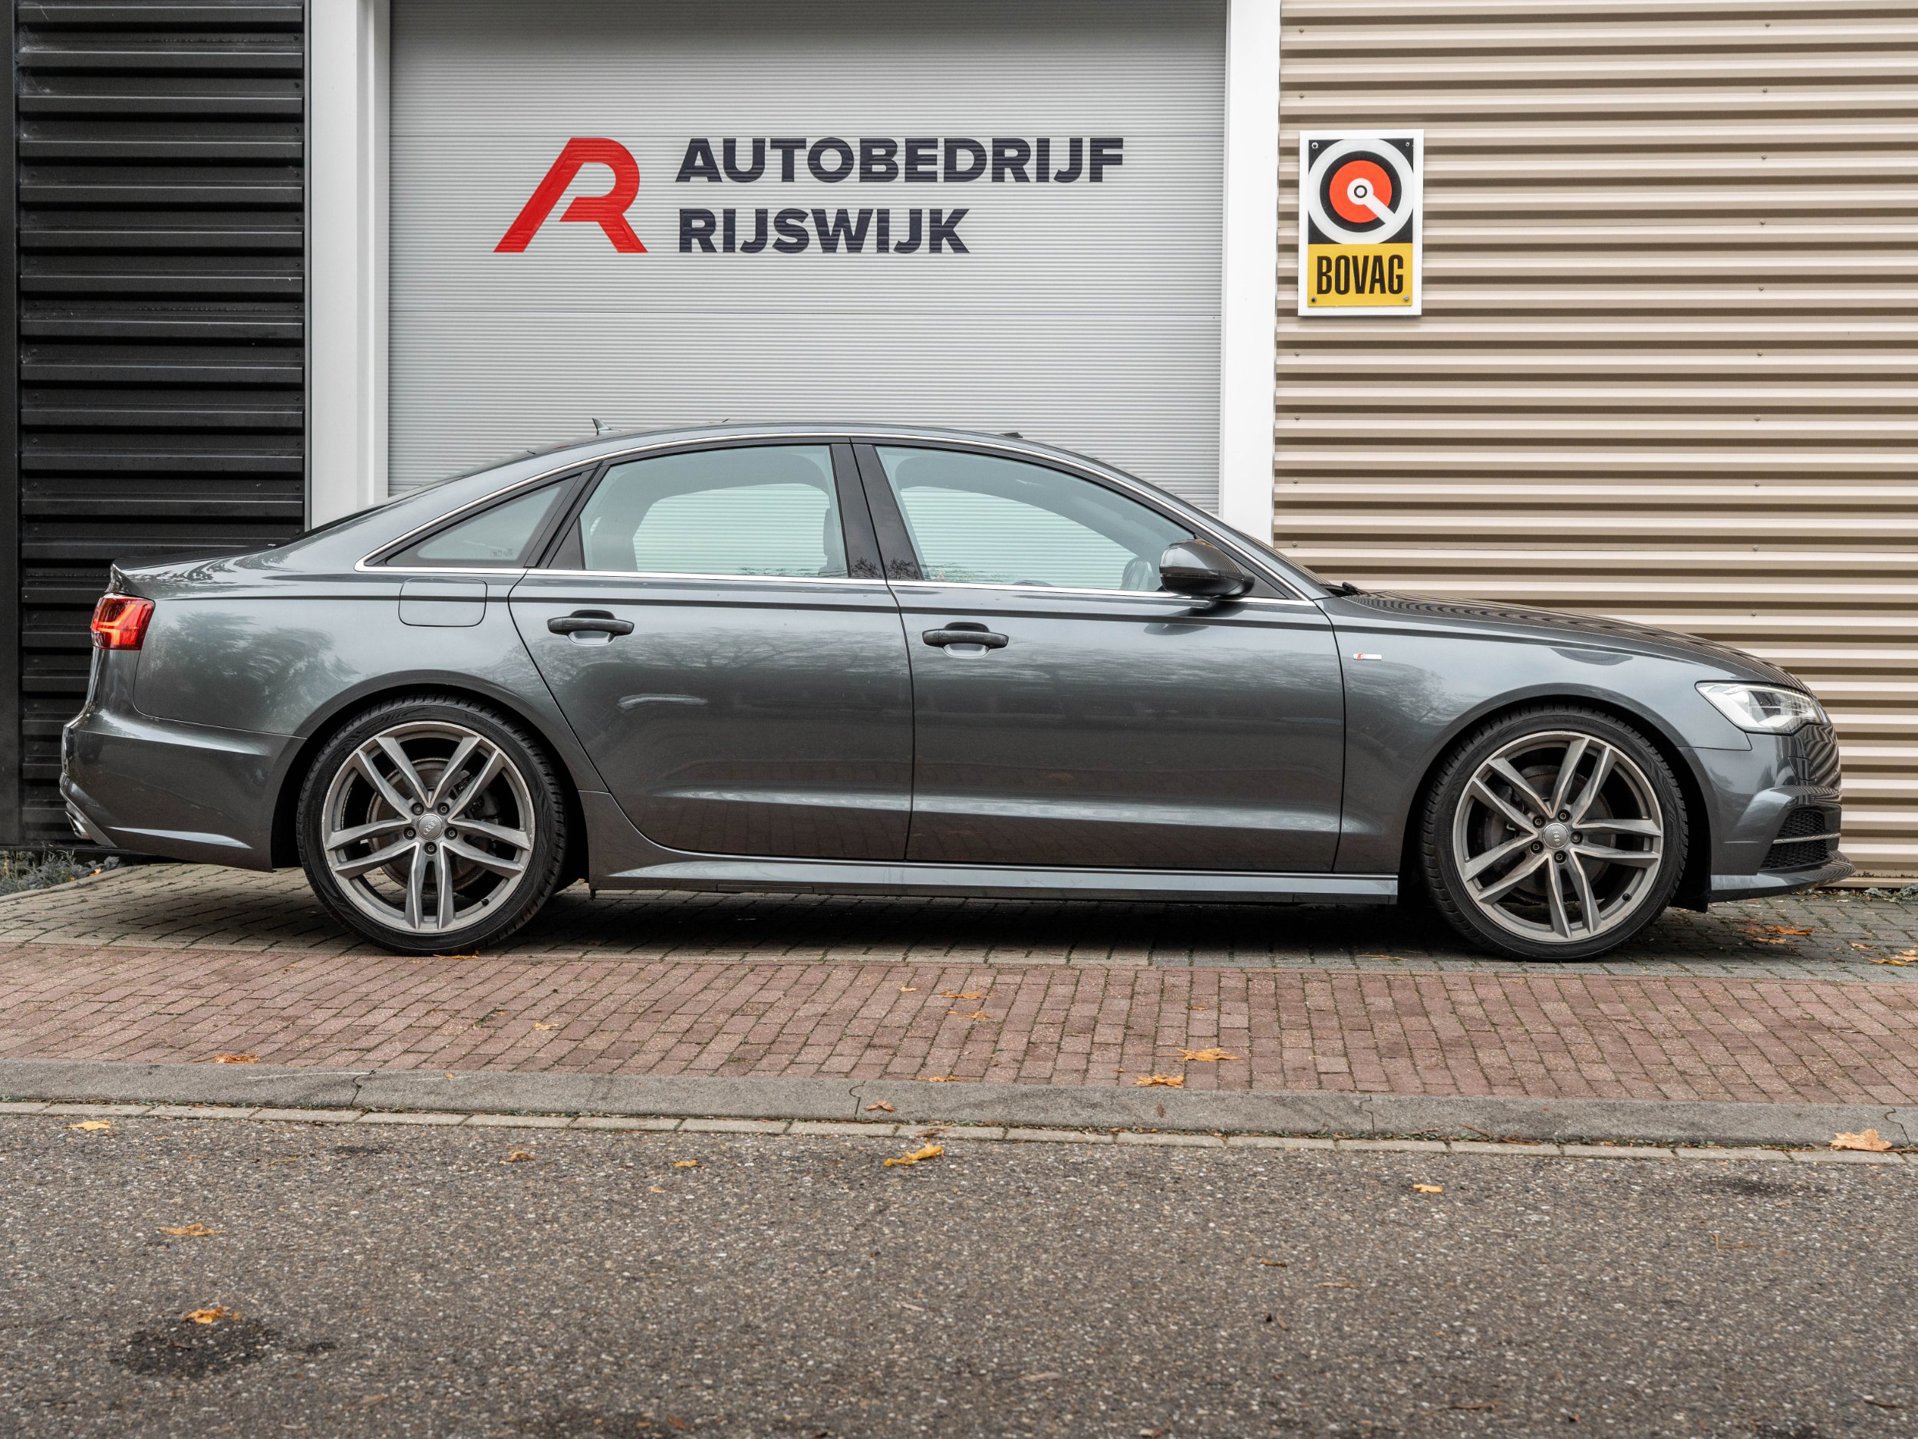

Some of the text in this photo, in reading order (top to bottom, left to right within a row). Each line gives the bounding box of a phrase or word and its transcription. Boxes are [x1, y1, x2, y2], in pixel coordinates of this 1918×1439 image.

[676, 137, 1124, 183] AUTOBEDRIJF
[679, 208, 970, 254] RIJSWIJK
[1316, 254, 1404, 296] BOVAG
